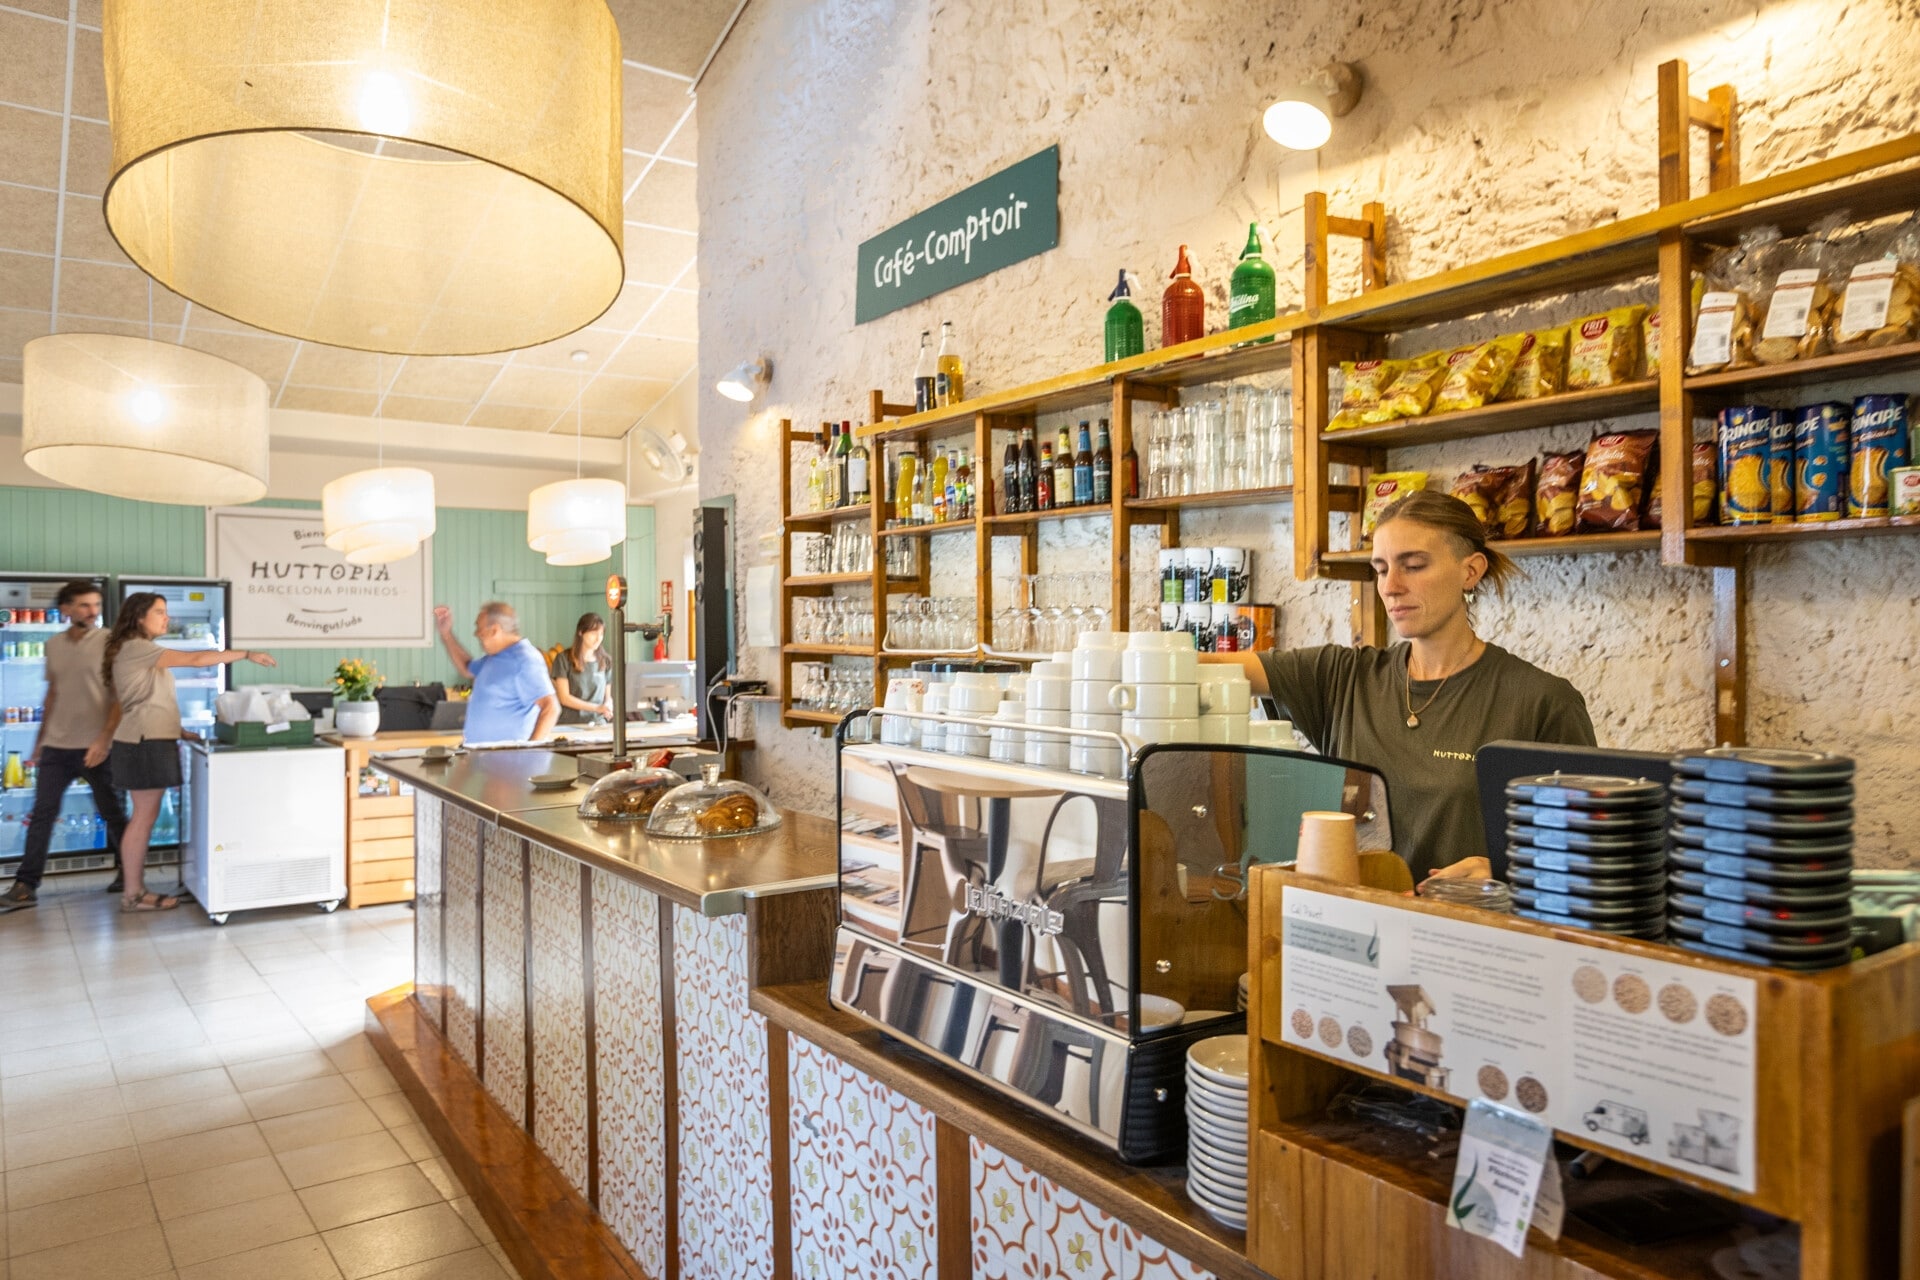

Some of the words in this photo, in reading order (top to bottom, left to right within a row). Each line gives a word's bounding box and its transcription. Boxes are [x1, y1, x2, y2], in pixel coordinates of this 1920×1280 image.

[874, 193, 1028, 288] Café-Comptoir
[251, 561, 391, 581] HUTTOPIA
[248, 585, 332, 597] BARCELONA
[337, 586, 399, 598] PIRINEOS
[1433, 750, 1477, 762] HUTTOPI
